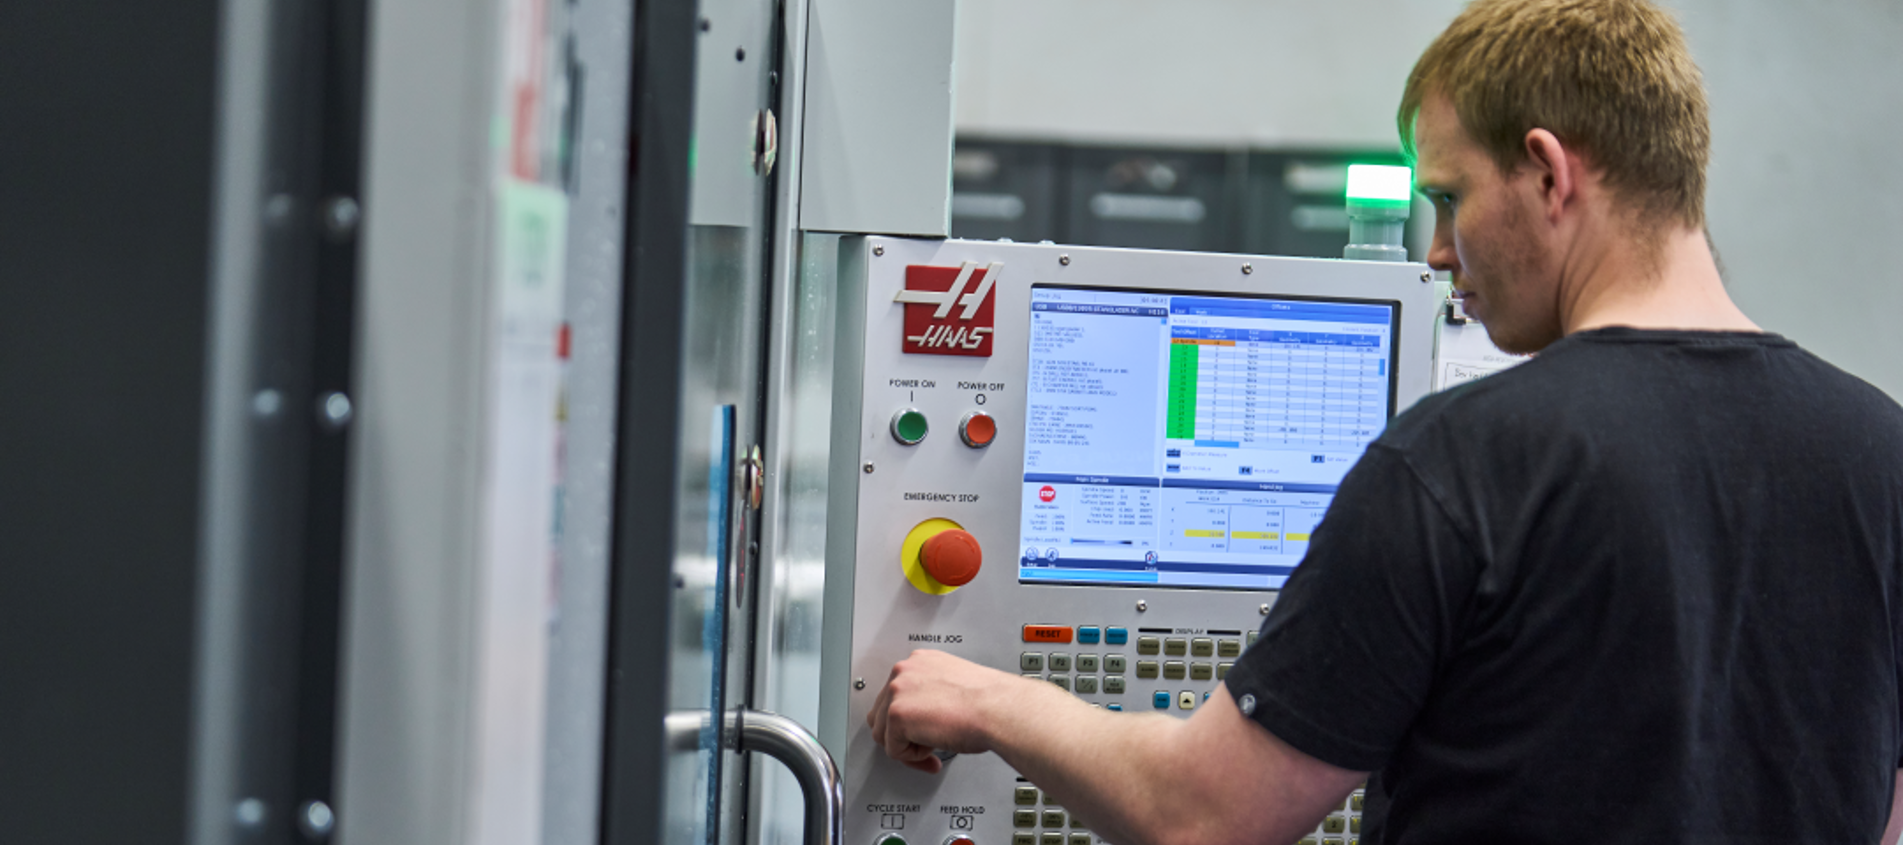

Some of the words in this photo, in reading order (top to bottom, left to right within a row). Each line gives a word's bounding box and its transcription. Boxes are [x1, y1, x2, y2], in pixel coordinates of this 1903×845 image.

[907, 325, 993, 349] HAAS
[889, 379, 919, 388] POWER
[921, 380, 936, 388] ON
[957, 381, 987, 390] POWER
[989, 383, 1005, 391] OFF
[904, 492, 957, 502] EMERGENCY
[959, 494, 979, 502] STOP
[909, 634, 941, 643] HANDLE
[944, 635, 963, 643] JOG
[1035, 630, 1061, 638] RESET
[867, 804, 895, 813] CYCLE
[897, 804, 920, 813] START
[941, 806, 959, 814] FEED
[962, 806, 985, 814] HOLD
